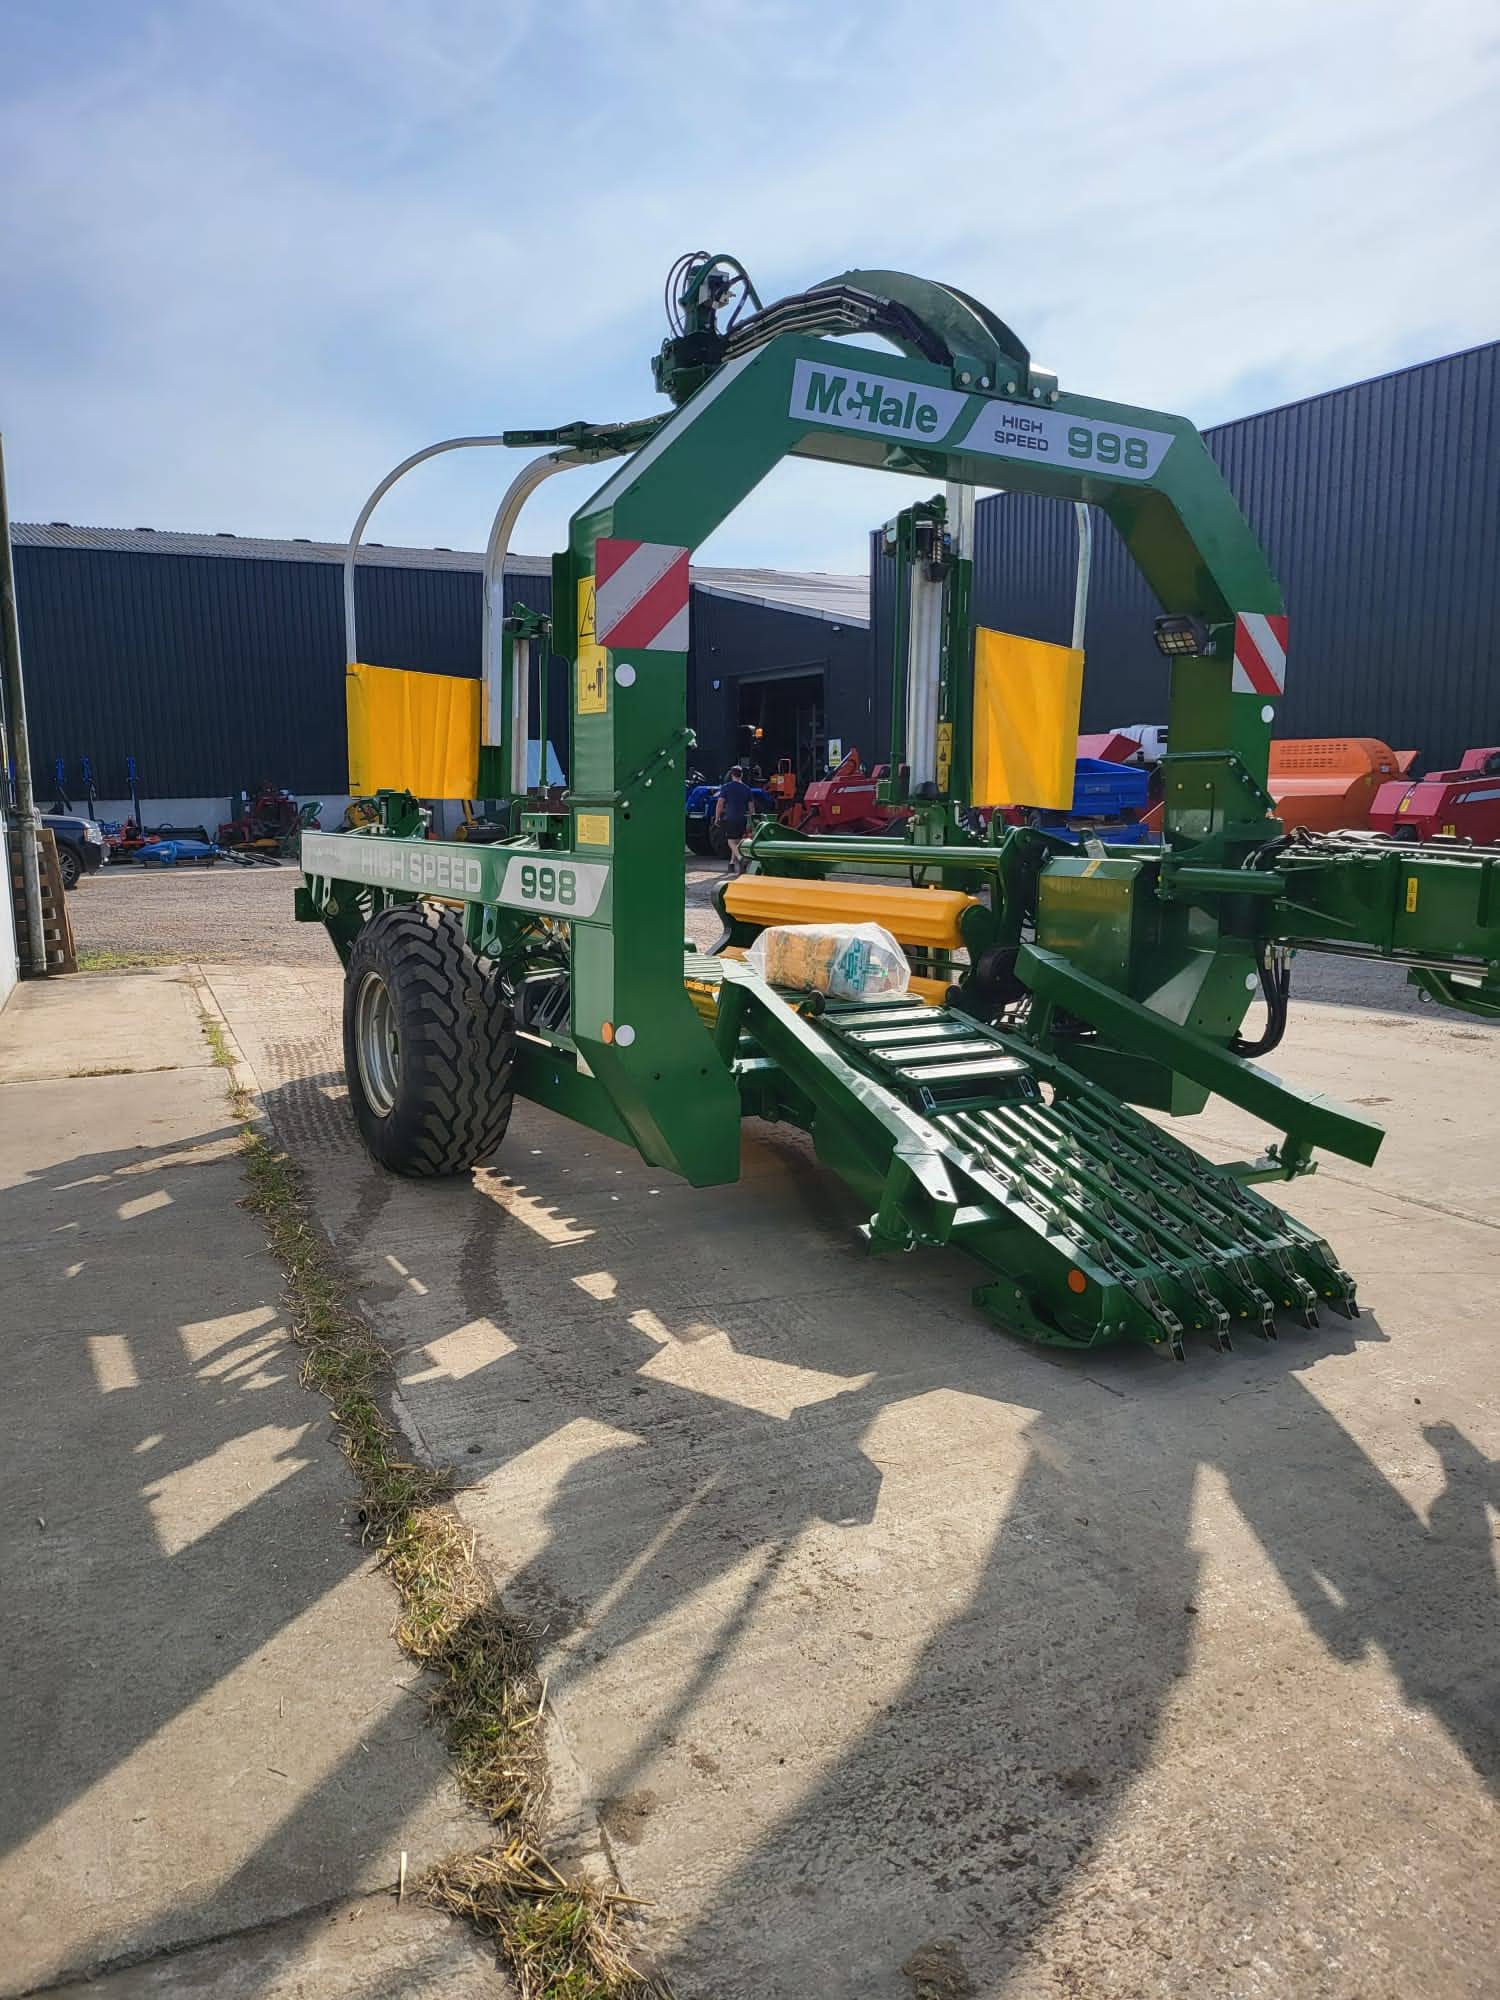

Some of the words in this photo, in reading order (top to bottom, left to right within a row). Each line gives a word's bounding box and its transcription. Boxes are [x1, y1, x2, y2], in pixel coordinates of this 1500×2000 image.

[805, 371, 938, 433] McHale
[993, 430, 1049, 452] SPEED
[1001, 414, 1043, 435] HIGH
[1067, 426, 1149, 470] 998
[361, 847, 405, 881] HIGH
[409, 852, 482, 893] SPEED
[520, 864, 577, 906] 998
